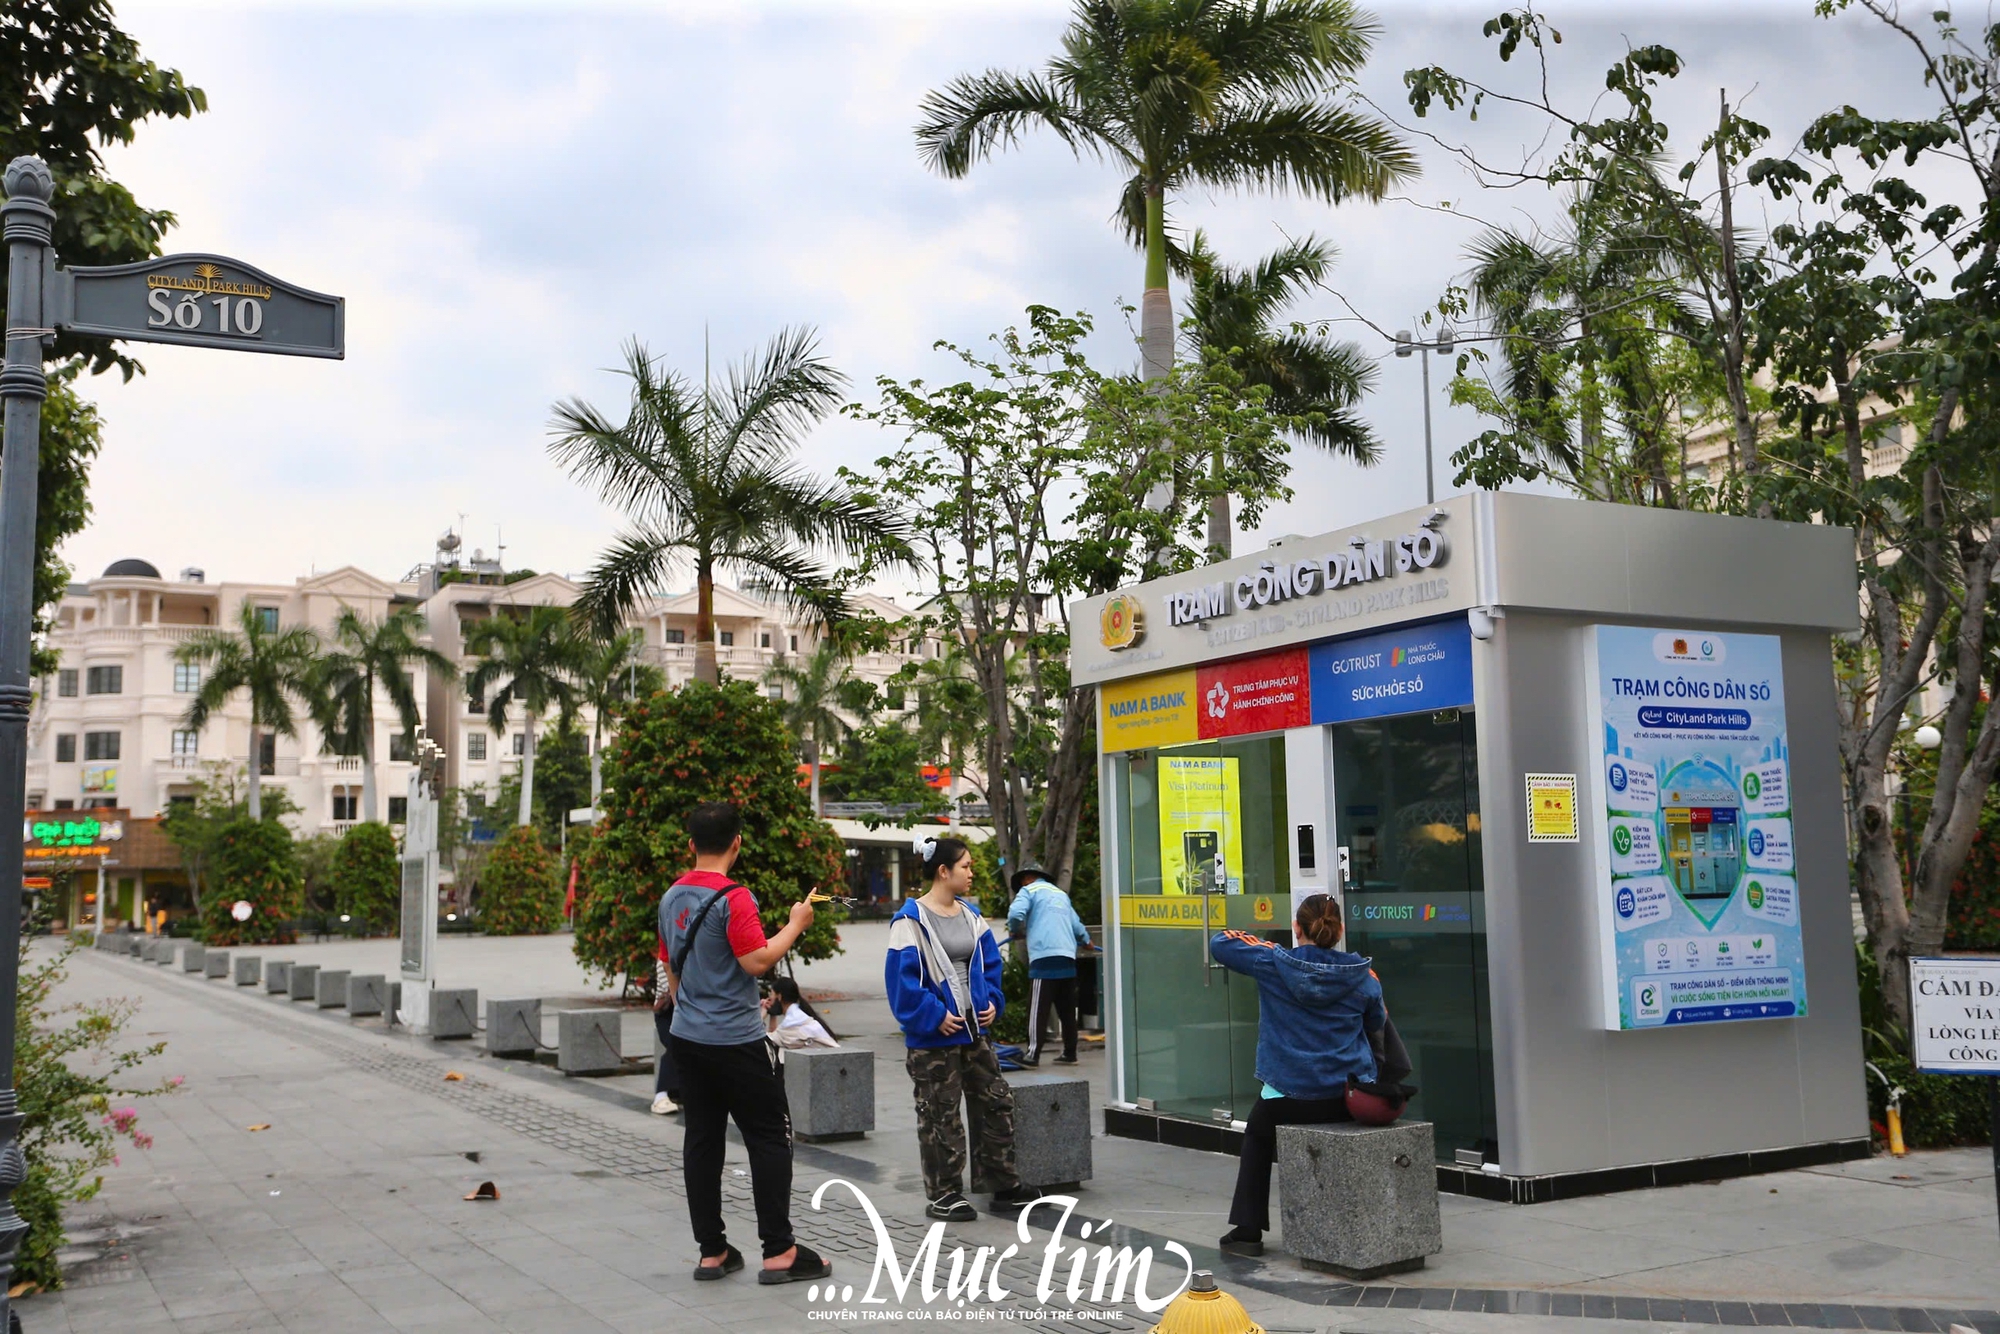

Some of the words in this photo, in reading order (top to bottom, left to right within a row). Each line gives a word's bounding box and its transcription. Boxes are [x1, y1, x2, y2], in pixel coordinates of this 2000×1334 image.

[148, 275, 204, 289] CITYLAND
[213, 281, 239, 292] PARK
[243, 284, 270, 295] HILLS
[147, 287, 203, 330] Số
[212, 296, 263, 335] 10
[1163, 581, 1231, 631] TRẠM
[1233, 559, 1322, 611] CÔNG
[1323, 535, 1392, 591] DÂN
[1395, 507, 1449, 573] SỐ
[1260, 614, 1285, 635] HUB
[1294, 601, 1363, 630] CITYLAND
[1366, 589, 1406, 614] PARK
[1408, 578, 1449, 605] HILLS
[1407, 646, 1418, 655] NHÀ
[1419, 642, 1437, 652] THUỐC
[1332, 653, 1382, 674] GOTRUST
[1407, 654, 1426, 665] LONG
[1426, 651, 1446, 663] CHÂU
[1233, 682, 1255, 694] TRUNG
[1255, 678, 1269, 690] TÂM
[1270, 677, 1288, 689] PHỤC
[1288, 675, 1299, 687] VỤ
[1352, 685, 1375, 702] SỨC
[1375, 678, 1406, 699] KHỎE
[1407, 674, 1424, 693] SỐ
[1612, 677, 1659, 700] TRẠM
[1663, 676, 1710, 699] CÔNG
[1714, 678, 1747, 700] DÂN
[1749, 679, 1771, 701] SỐ
[1109, 698, 1139, 718] NAM
[1139, 697, 1150, 714] A
[1150, 691, 1187, 712] BANK
[1233, 698, 1252, 710] HÀNH
[1252, 694, 1275, 708] CHÍNH
[1275, 691, 1295, 705] CÔNG
[1666, 712, 1706, 725] CityLand
[1707, 713, 1727, 725] Park
[1728, 714, 1747, 725] Hills
[1201, 761, 1226, 769] BANK
[1168, 781, 1187, 791] Visa
[1189, 781, 1229, 791] Platinum
[1138, 903, 1169, 919] NAM
[1170, 903, 1181, 919] A
[1182, 902, 1220, 919] BAK
[1364, 906, 1414, 919] GOTRUST
[1670, 981, 1687, 991] TRẠM
[1687, 979, 1703, 989] CÔNG
[1704, 979, 1717, 988] DÂN
[1717, 978, 1725, 988] SỐ
[1731, 977, 1744, 986] ĐIỂM
[1745, 977, 1756, 986] ĐẾN
[1757, 976, 1775, 985] THÔNG
[1919, 975, 1971, 996] CẤM
[1671, 994, 1678, 1003] VÌ
[1679, 994, 1697, 1004] CUỘC
[1698, 991, 1716, 1001] SỐNG
[1717, 990, 1732, 1001] TIỆN
[1732, 989, 1744, 999] ÍCH
[1744, 989, 1759, 998] HƠN
[1759, 987, 1771, 997] MỖI
[1771, 986, 1789, 997] NGÀY!
[1640, 1008, 1660, 1016] Citizen
[1929, 1024, 1976, 1040] LÒNG
[1949, 1045, 1998, 1061] CÔNG
